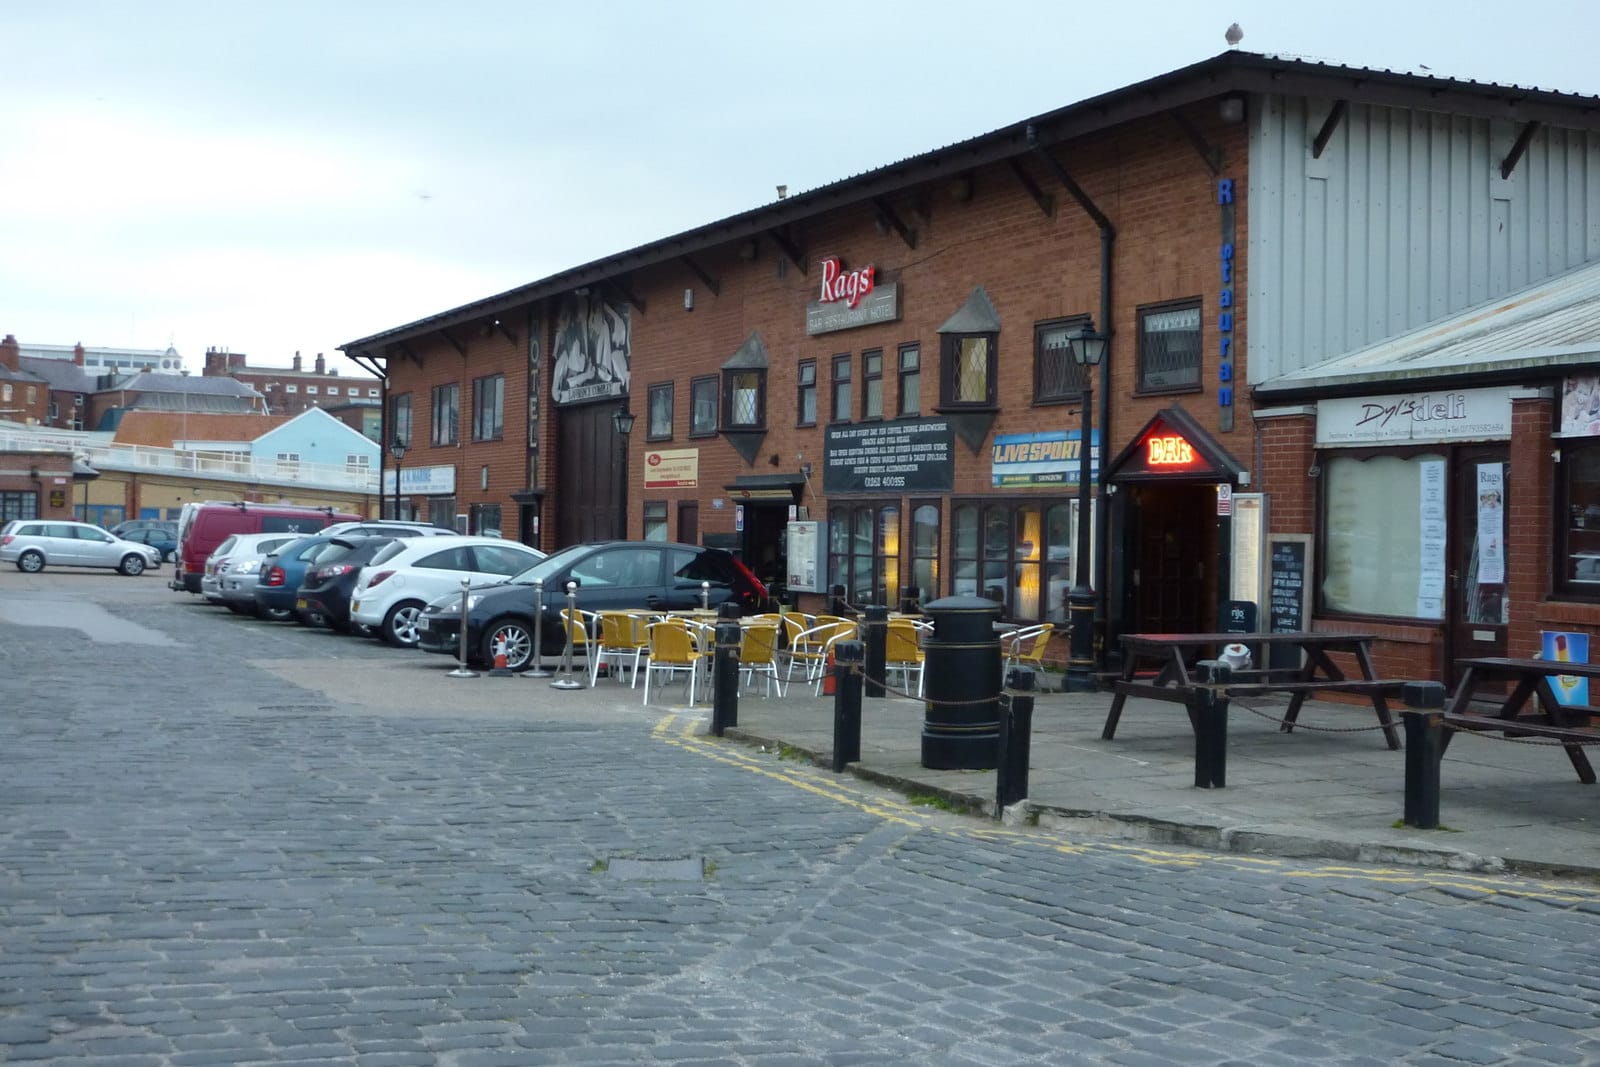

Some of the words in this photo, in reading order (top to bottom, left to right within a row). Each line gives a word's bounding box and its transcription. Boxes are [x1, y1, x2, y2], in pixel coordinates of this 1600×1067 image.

[819, 257, 874, 309] Rags
[870, 304, 893, 320] HOTEL
[1356, 399, 1416, 427] Dyl's
[1413, 393, 1466, 421] deli
[1148, 436, 1193, 465] BAR
[1480, 471, 1501, 485] Rags
